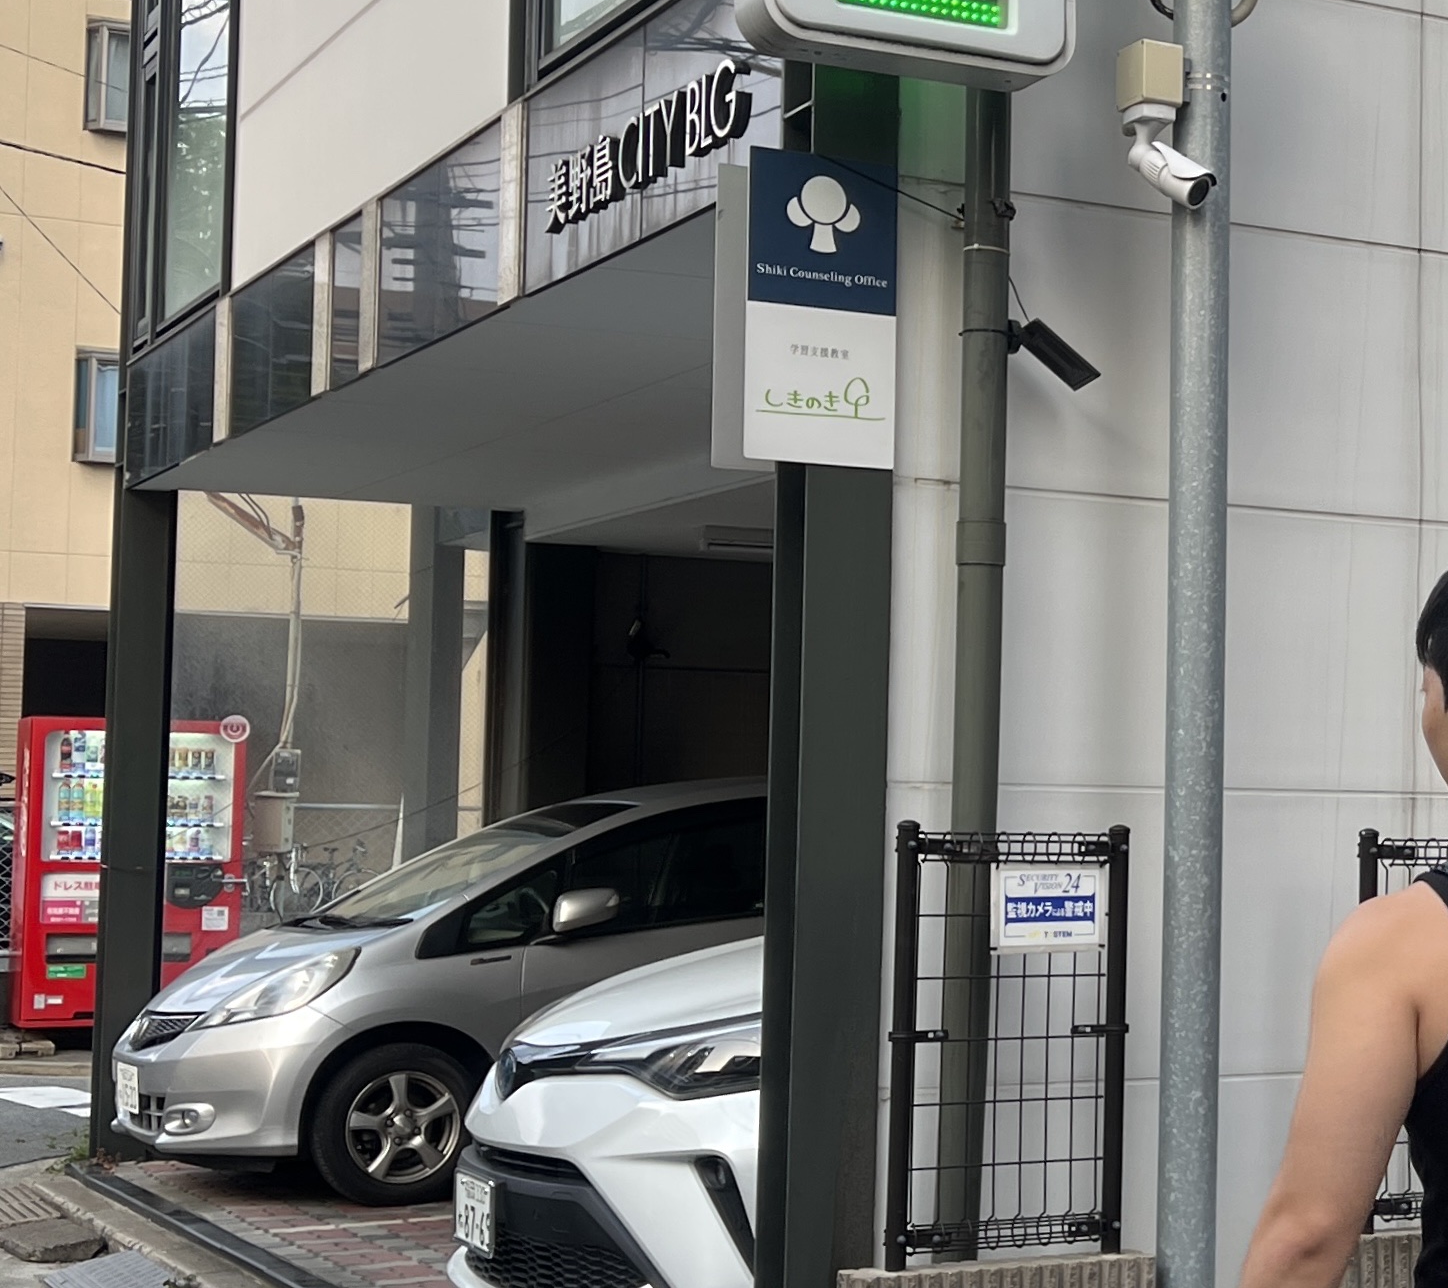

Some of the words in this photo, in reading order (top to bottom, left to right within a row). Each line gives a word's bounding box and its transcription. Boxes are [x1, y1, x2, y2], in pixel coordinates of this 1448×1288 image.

[545, 134, 614, 225] 美野島
[618, 90, 682, 190] CITY
[685, 58, 740, 157] BLG
[756, 262, 787, 279] Shiki
[789, 266, 852, 287] Counseling
[854, 273, 888, 290] Office
[764, 388, 840, 412] しきのき
[1017, 873, 1059, 887] SECURITY
[1062, 872, 1081, 893] 24
